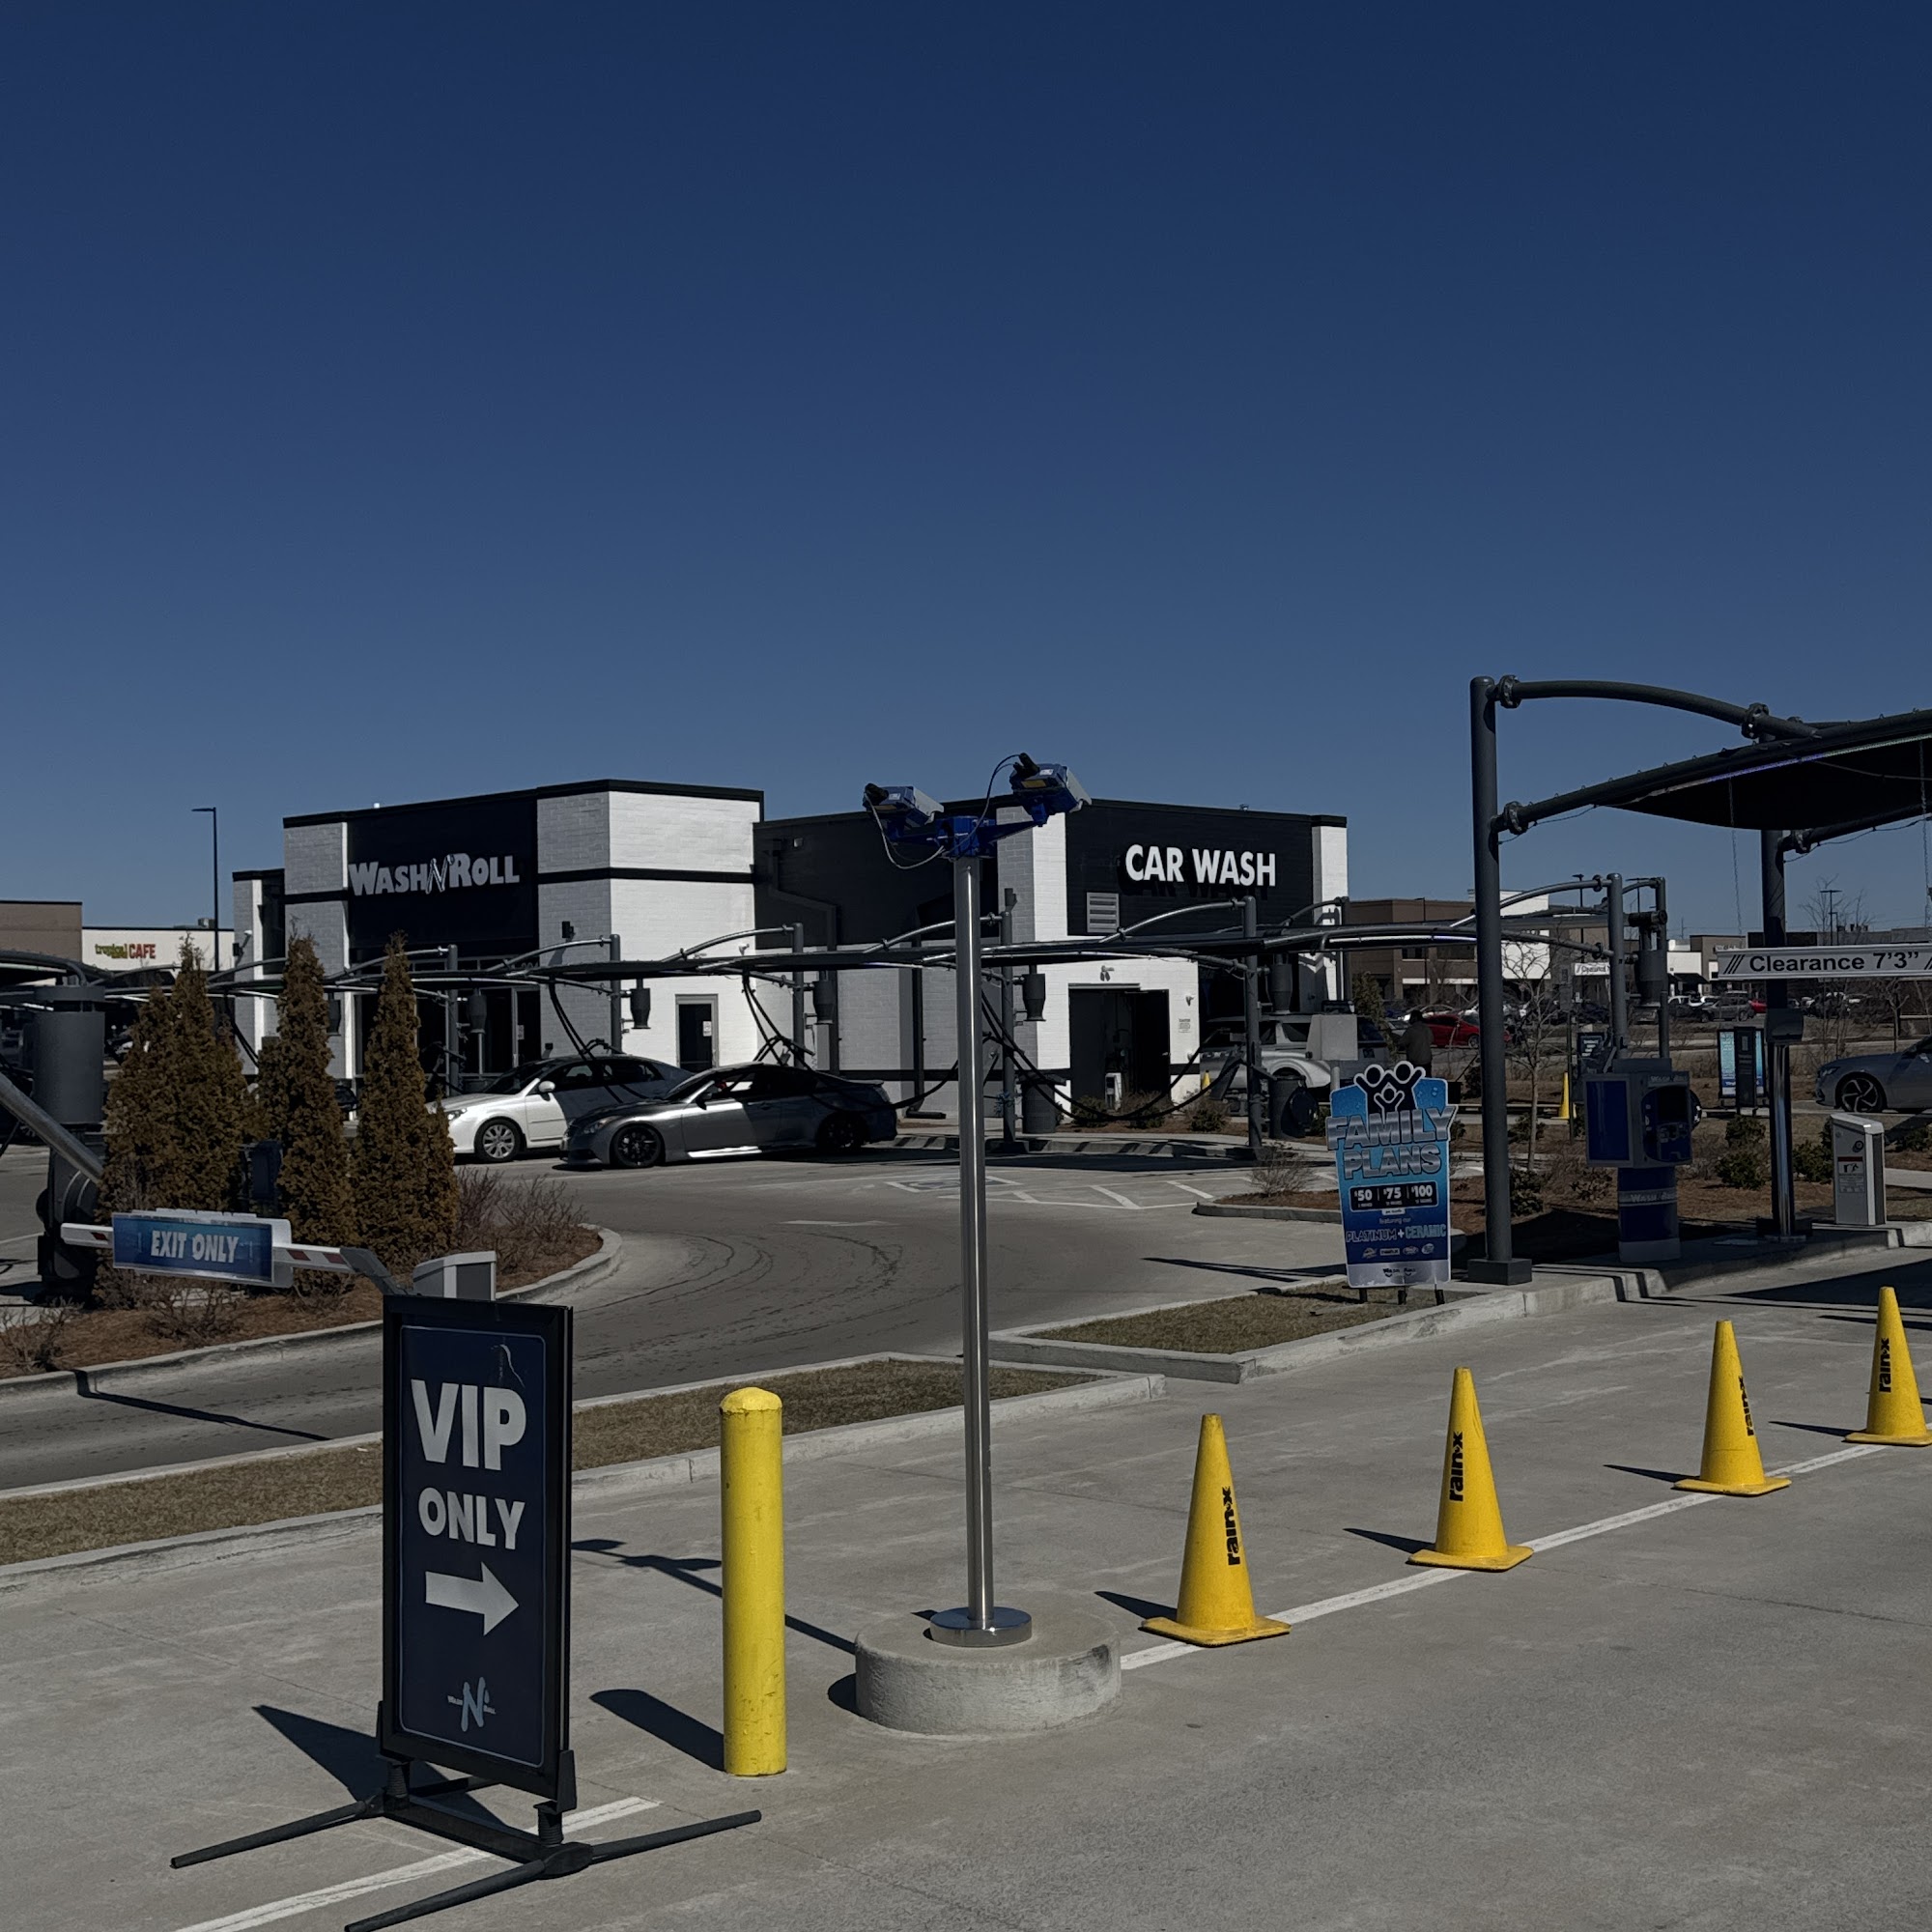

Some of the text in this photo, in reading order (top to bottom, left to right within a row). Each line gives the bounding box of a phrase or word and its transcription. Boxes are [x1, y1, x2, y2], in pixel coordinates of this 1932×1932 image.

[348, 861, 428, 896] WASH
[449, 853, 521, 888] ROLL
[1125, 843, 1276, 887] CAR WASH
[128, 944, 156, 958] CAFE
[1749, 954, 1865, 972] Clearance
[1326, 1106, 1456, 1151] FAMILY
[1343, 1144, 1442, 1179] PLANS
[1354, 1184, 1434, 1202] $50 $75 $100
[151, 1230, 240, 1264] EXIT ONLY
[1346, 1228, 1397, 1243] PLATINUM
[1405, 1224, 1446, 1239] CERAMIC
[411, 1378, 526, 1471] VIP
[418, 1487, 526, 1550] ONLY
